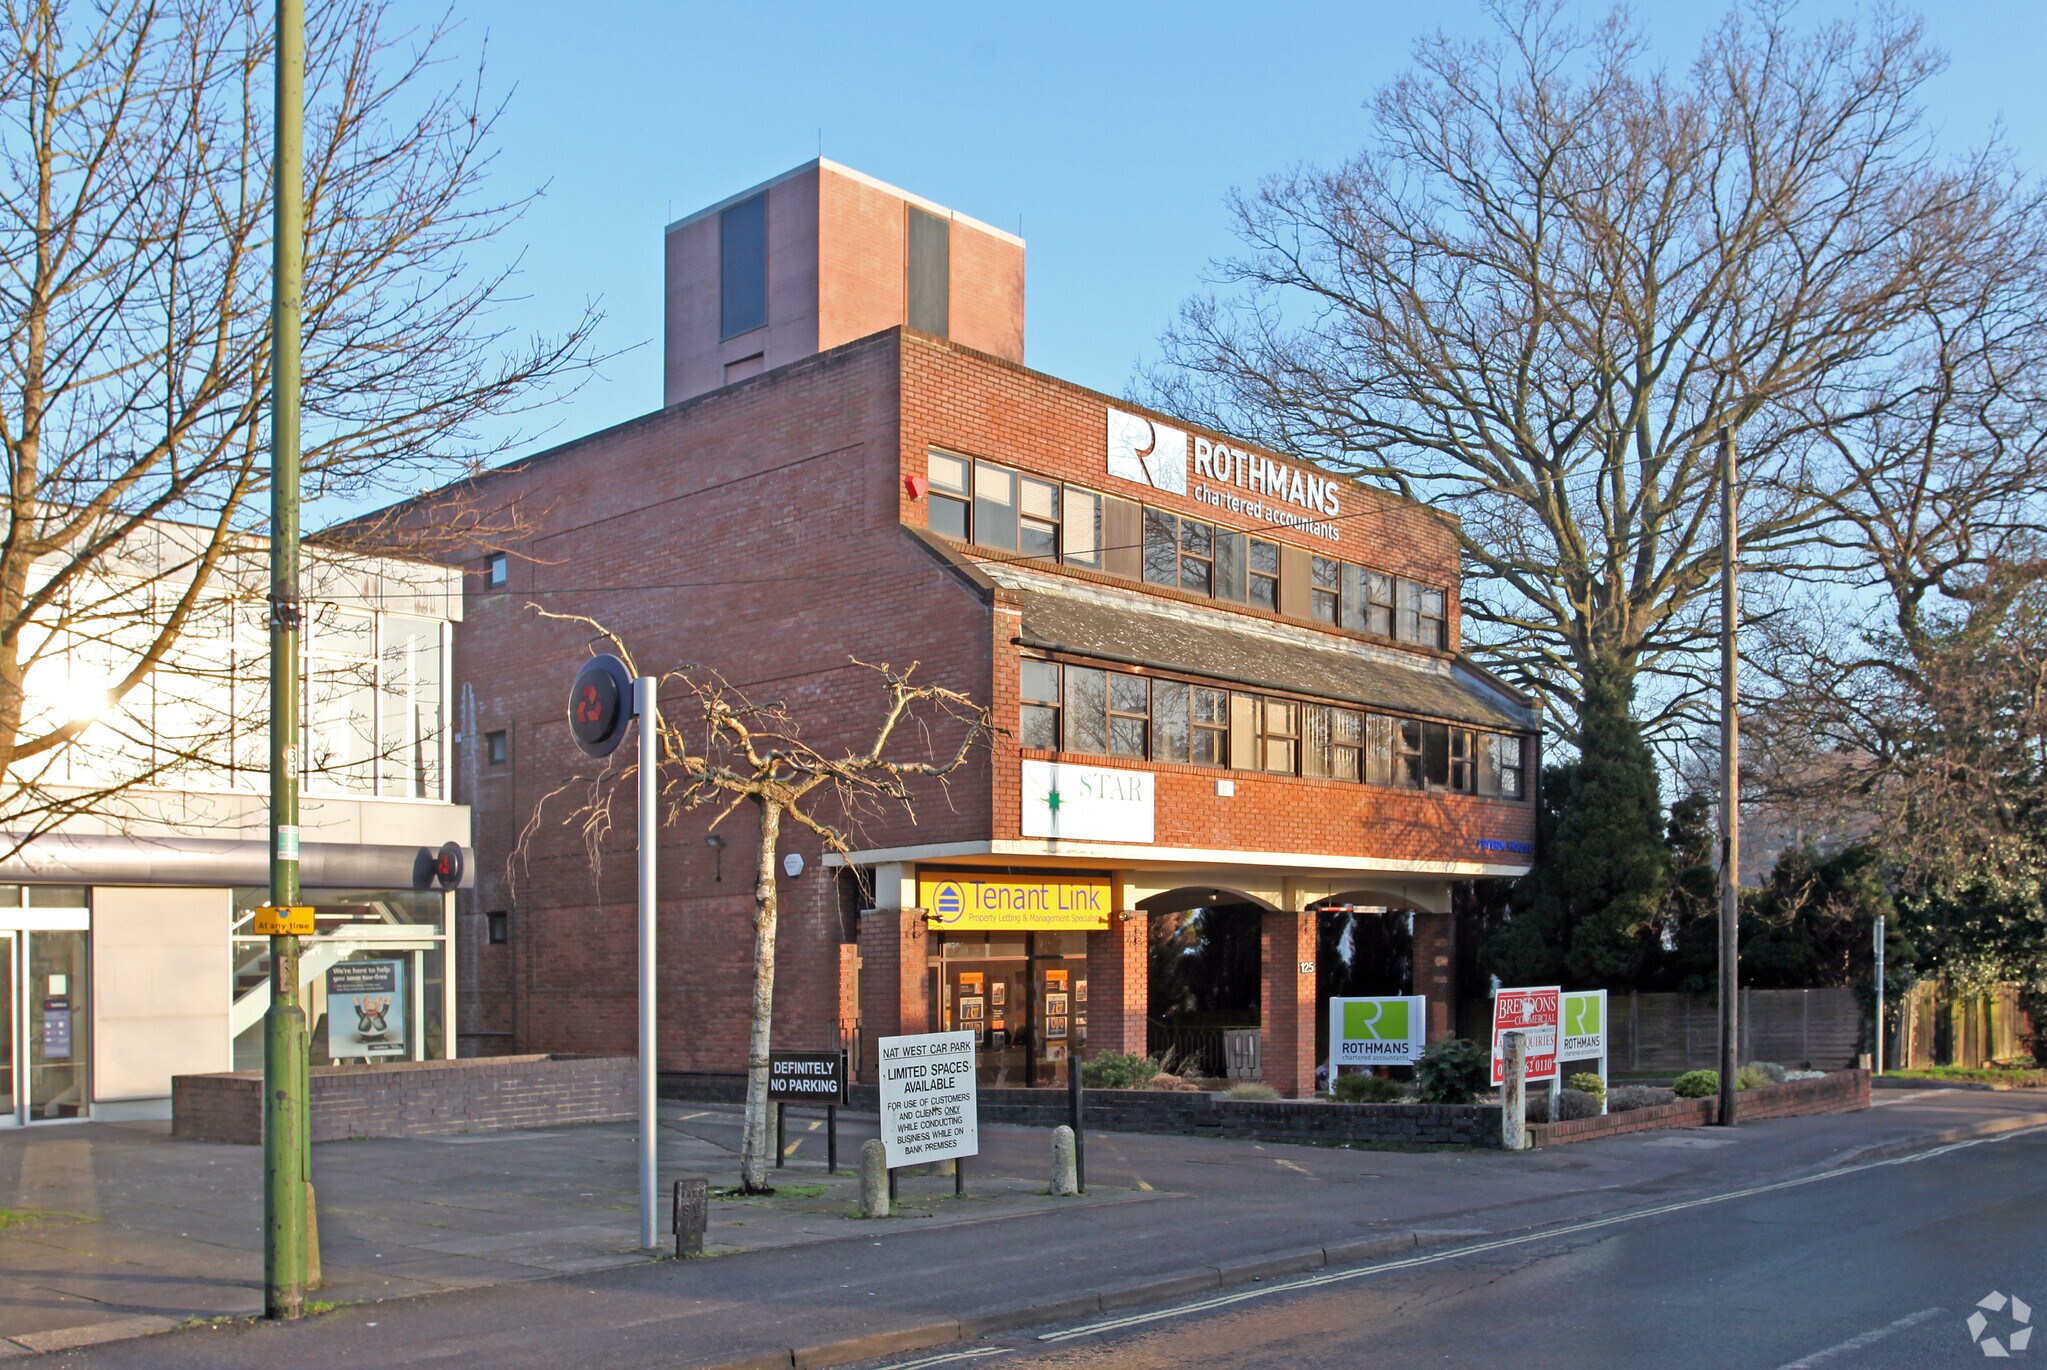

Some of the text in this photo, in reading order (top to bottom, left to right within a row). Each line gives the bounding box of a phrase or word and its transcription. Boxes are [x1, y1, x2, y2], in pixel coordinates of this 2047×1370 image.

[1193, 436, 1340, 517] ROTHMANS
[1194, 483, 1340, 542] chartered accountants
[1079, 772, 1142, 802] STAR
[969, 880, 1101, 911] Tenant Link
[968, 913, 997, 924] Property
[998, 914, 1021, 923] Letting
[1022, 914, 1028, 922] &
[1029, 914, 1071, 924] Management
[332, 967, 352, 975] We're
[352, 966, 367, 974] here
[376, 965, 391, 974] help
[1300, 962, 1314, 973] 125
[883, 1041, 971, 1058] NAT WEST CAR PARK
[1342, 1042, 1409, 1054] ROTHMANS
[1525, 1035, 1555, 1050] QUIRIES
[1564, 1035, 1601, 1050] ROTHMANS
[774, 1061, 834, 1075] DEFINITELY
[887, 1061, 969, 1080] LIMITED SPACES
[1535, 1058, 1552, 1072] 0110
[771, 1078, 838, 1093] NO PARKING
[904, 1077, 955, 1094] AVAILABLE
[888, 1093, 971, 1111] FOR USE OF CUSTOMERS
[899, 1105, 960, 1120] AND CLIENTS ONLY
[897, 1116, 963, 1133] WHILE CONDUCTING
[897, 1127, 964, 1144] BUSINESS WHILE ON
[905, 1139, 958, 1155] BANK PREMISES
